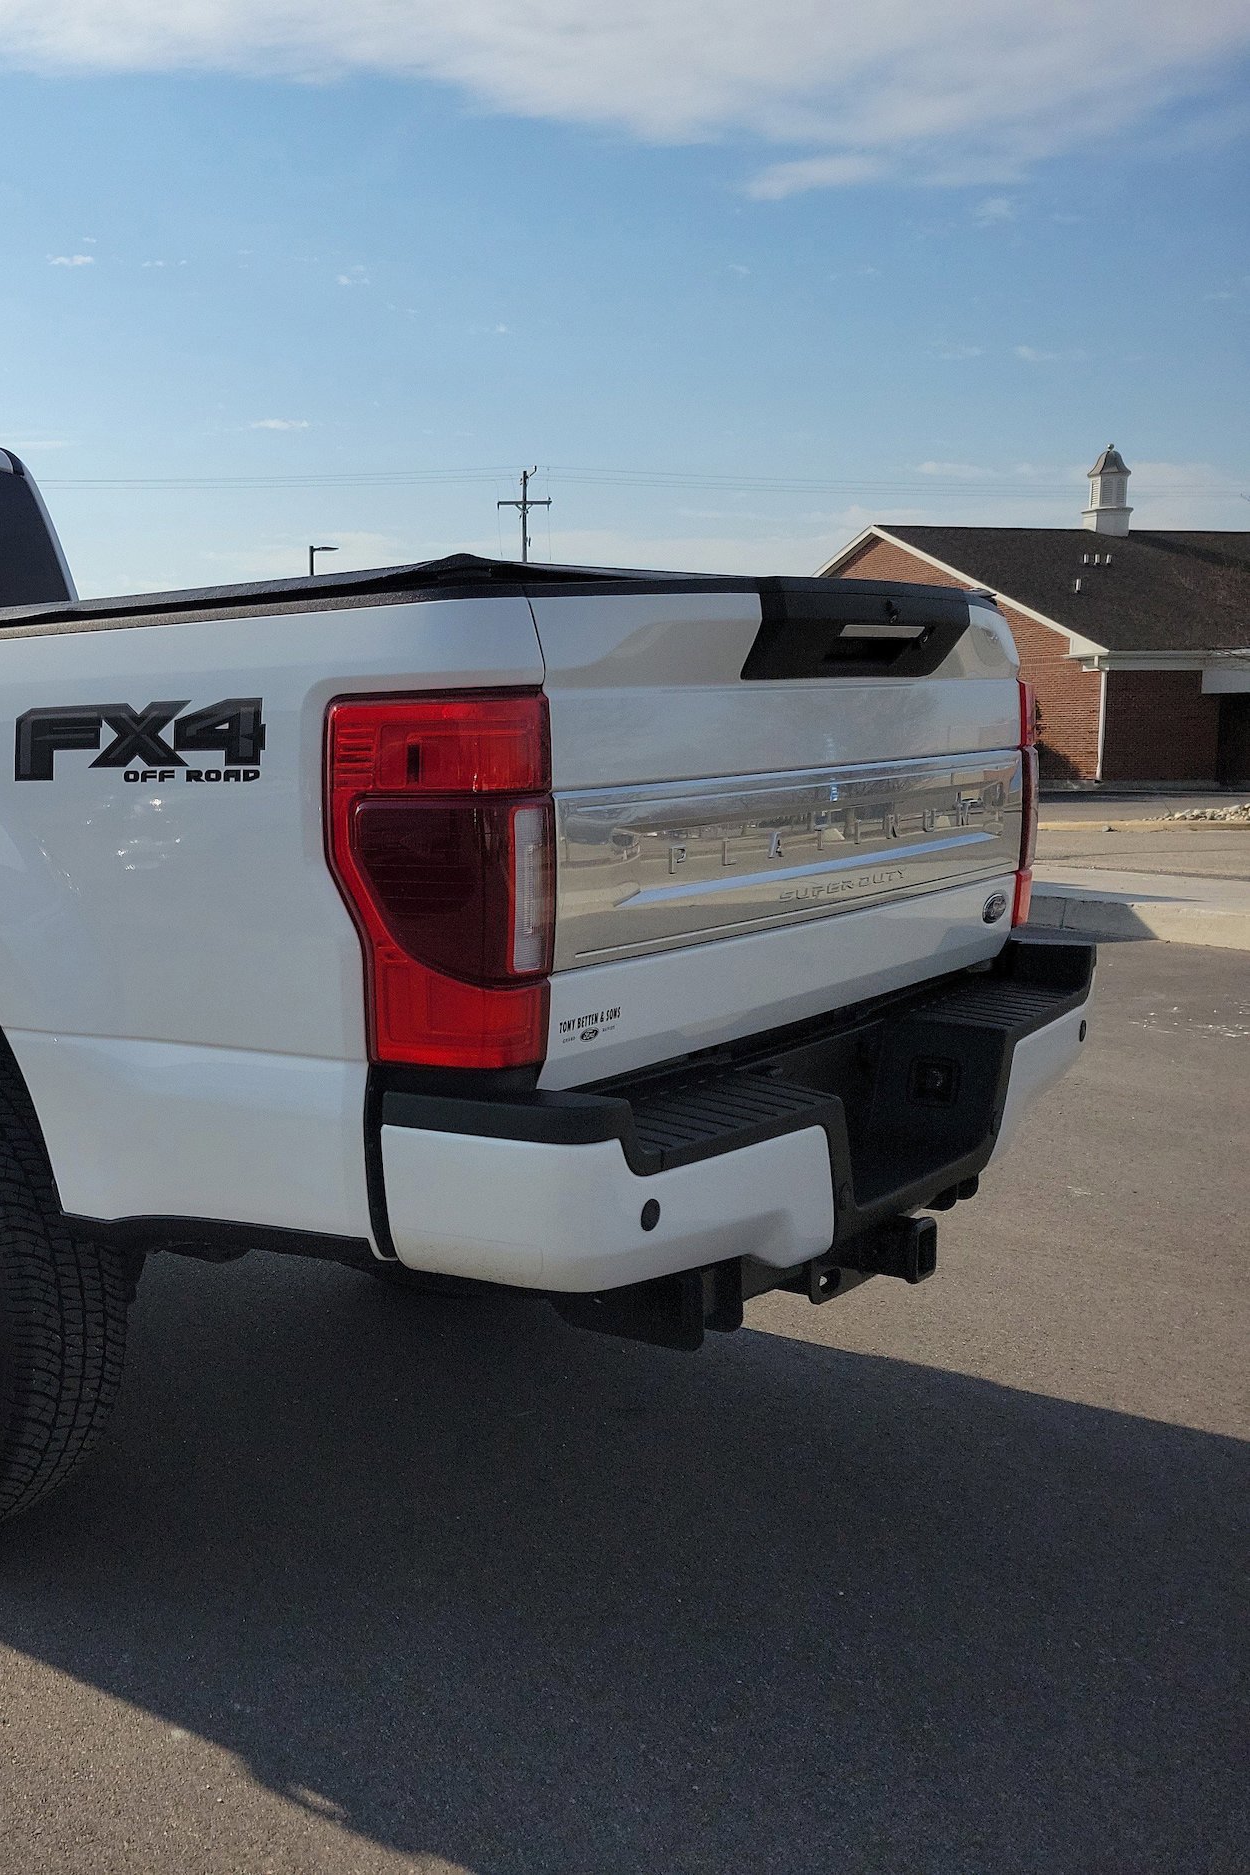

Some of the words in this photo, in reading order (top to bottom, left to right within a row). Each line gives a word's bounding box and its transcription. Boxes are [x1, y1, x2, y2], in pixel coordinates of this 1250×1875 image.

[14, 697, 266, 782] FX4
[123, 769, 175, 783] OFF
[185, 769, 261, 783] ROAD
[668, 801, 971, 874] PLATINUM
[779, 878, 853, 901] SUPER
[858, 868, 906, 889] DUTY
[559, 1019, 576, 1034] TONY
[577, 1012, 599, 1028] BETTEN
[606, 1006, 620, 1021] SONS
